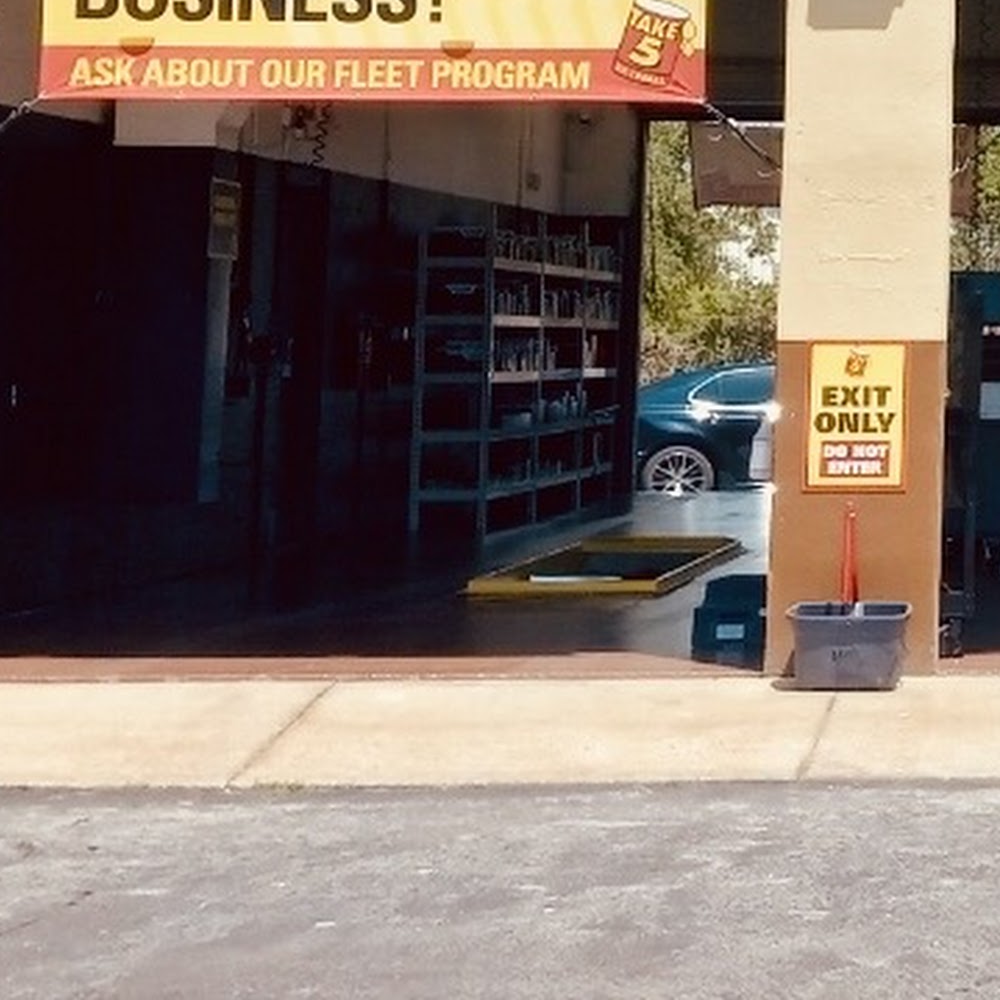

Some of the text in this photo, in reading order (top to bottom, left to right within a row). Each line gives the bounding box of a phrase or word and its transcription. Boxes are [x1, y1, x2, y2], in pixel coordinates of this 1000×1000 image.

[629, 7, 680, 40] TAKE
[628, 34, 664, 68] 5
[68, 57, 135, 88] ASK
[146, 57, 254, 88] ABOUT
[264, 58, 326, 89] OUR
[334, 59, 425, 89] FLEET
[431, 59, 591, 91] PROGRAM
[822, 386, 891, 407] EXIT
[814, 412, 895, 433] ONLY
[823, 444, 888, 458] DO NOT
